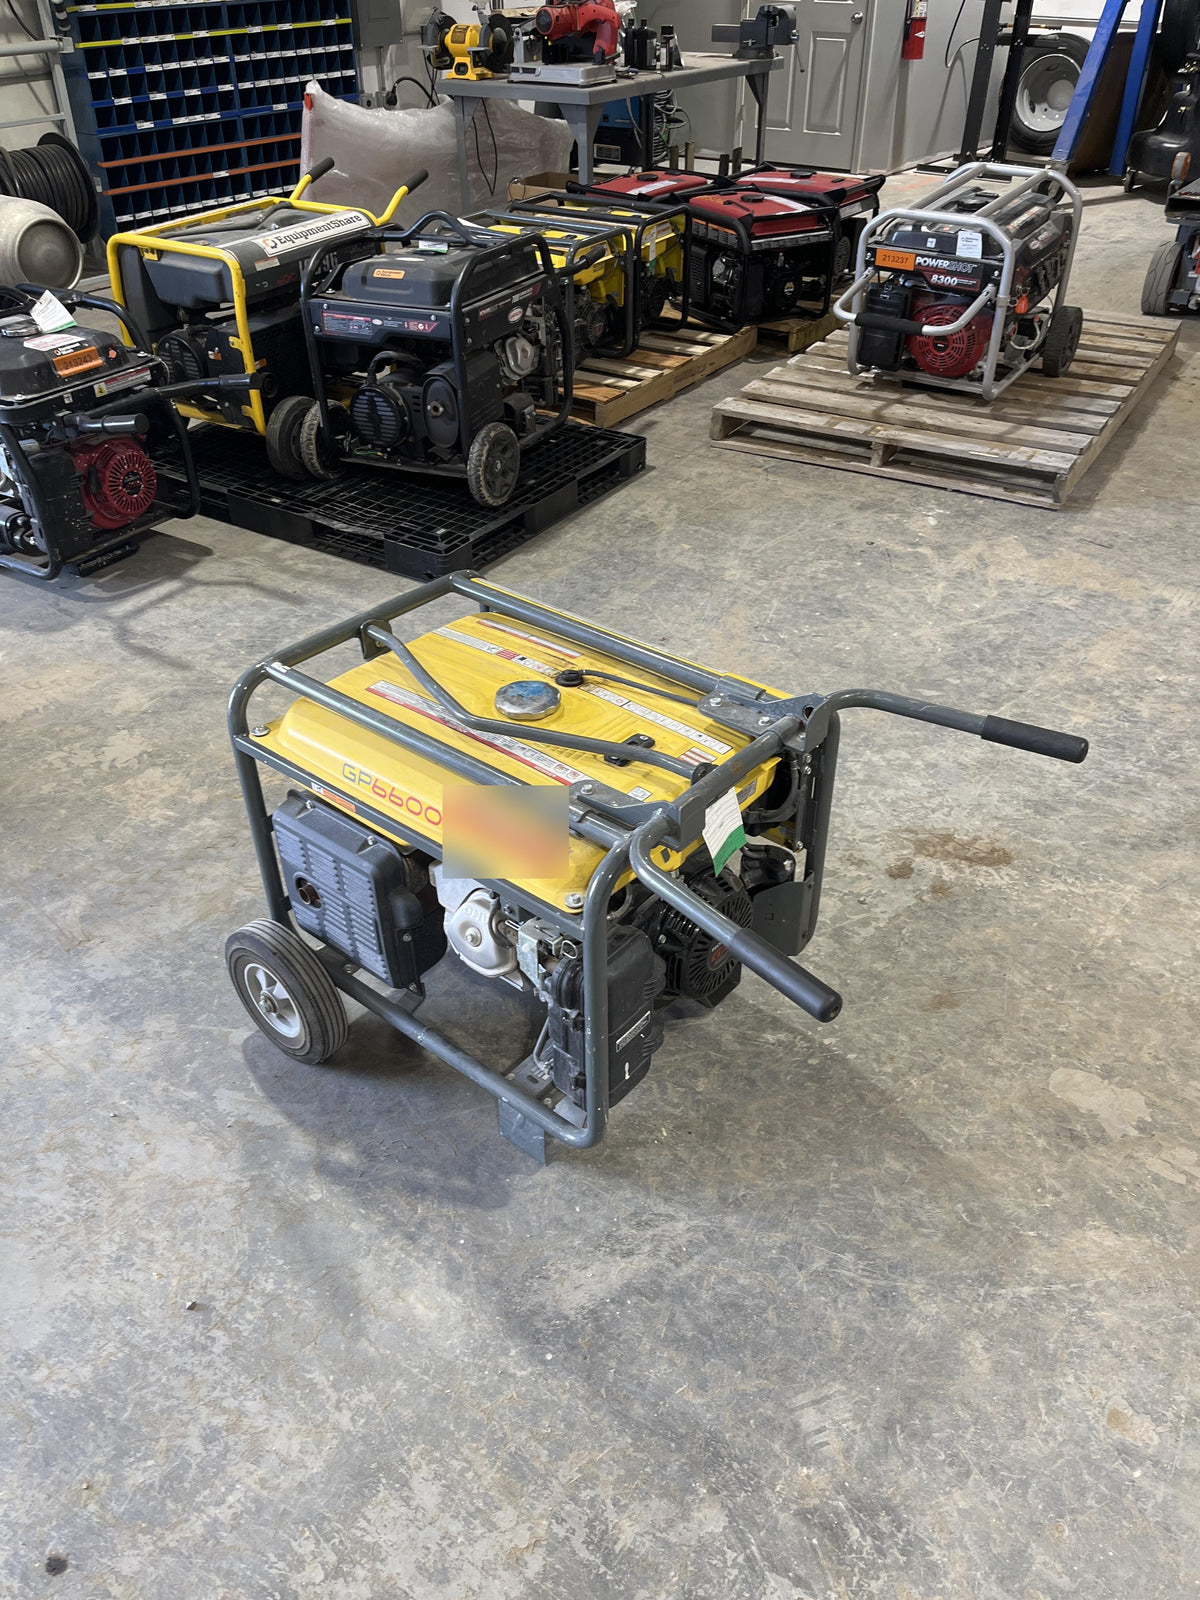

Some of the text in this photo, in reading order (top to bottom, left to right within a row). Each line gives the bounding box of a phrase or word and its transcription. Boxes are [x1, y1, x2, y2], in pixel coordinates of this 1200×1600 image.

[276, 213, 362, 245] EquipmentShare
[882, 253, 909, 264] 213237
[915, 256, 974, 274] POWERSHOT
[931, 274, 958, 286] 8300
[63, 353, 93, 370] 213243
[342, 762, 443, 826] GP6600
